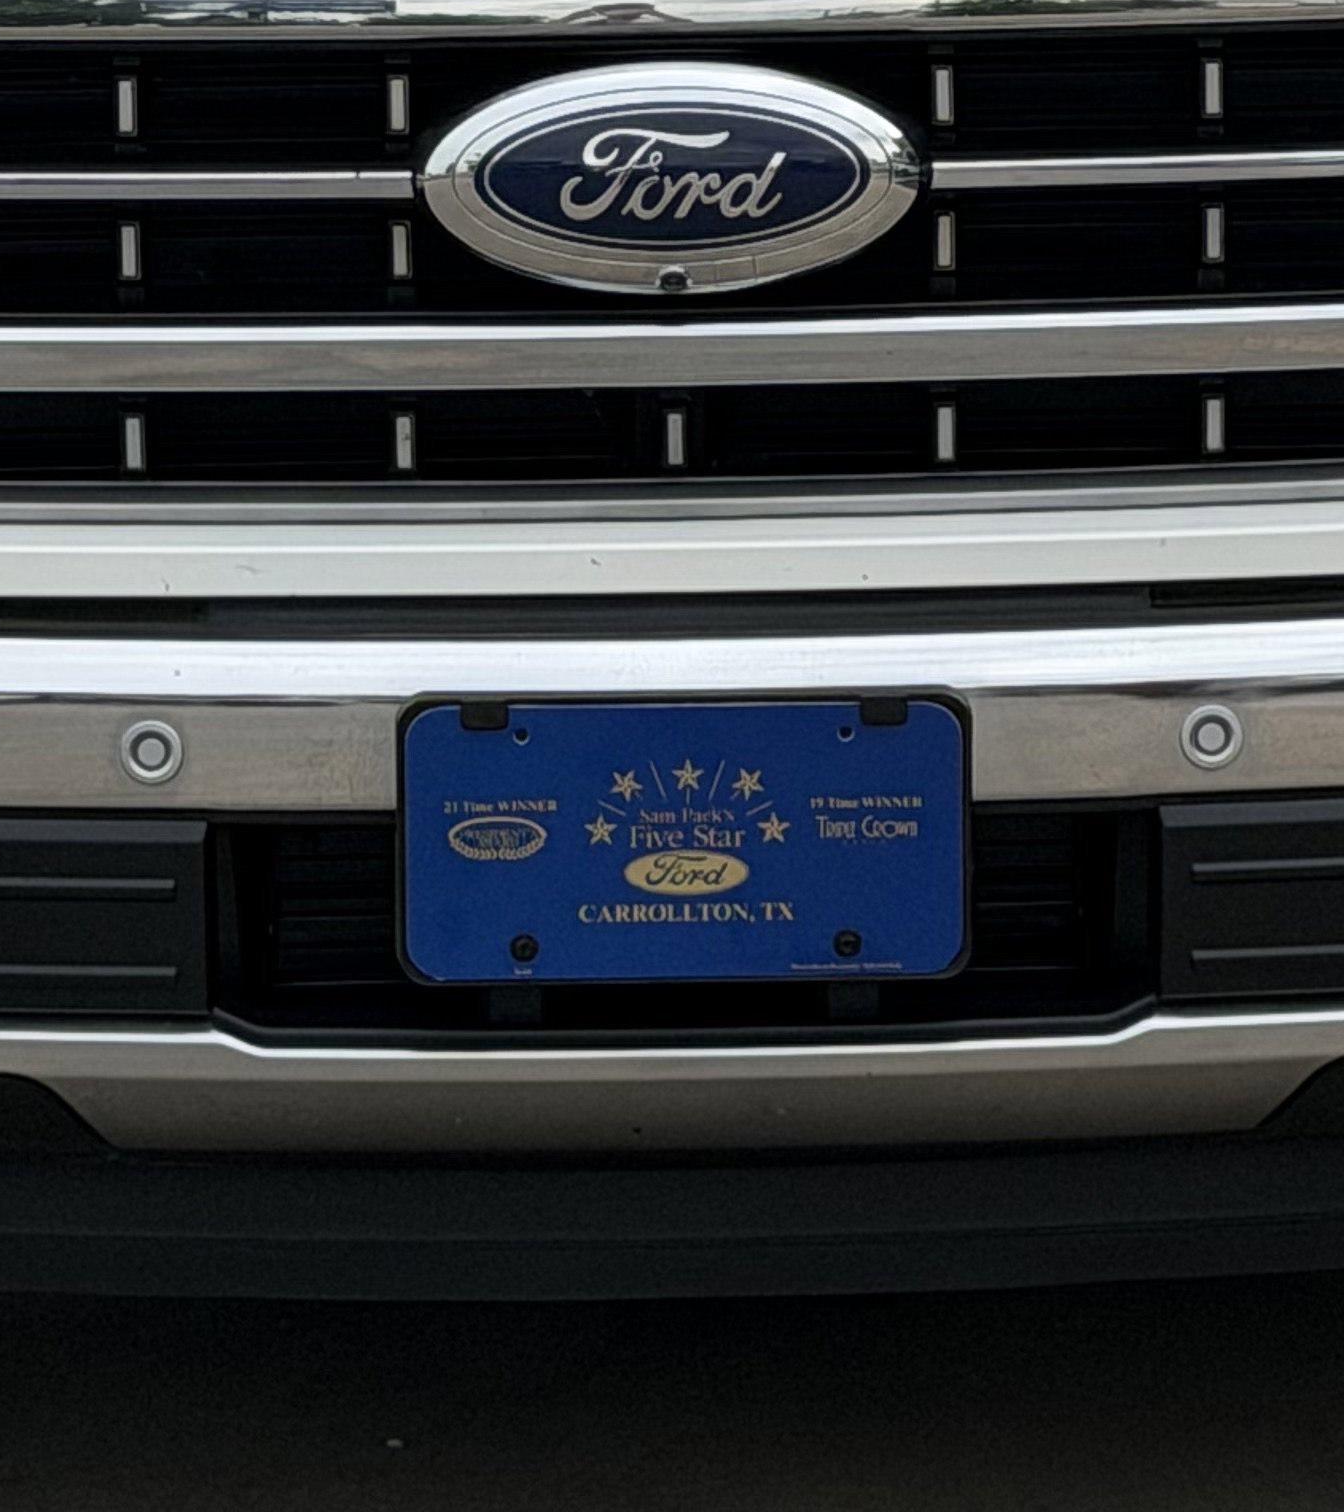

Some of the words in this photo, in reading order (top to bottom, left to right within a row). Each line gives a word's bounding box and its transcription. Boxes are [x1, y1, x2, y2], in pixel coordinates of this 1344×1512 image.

[559, 128, 788, 221] Ford
[498, 799, 557, 813] WINNER
[862, 795, 922, 808] WINNER
[639, 808, 676, 824] Sam
[629, 825, 684, 849] Five
[693, 824, 746, 848] Star
[644, 853, 729, 886] Ford
[577, 903, 755, 924] CARROLLTON,
[761, 901, 794, 922] TX
